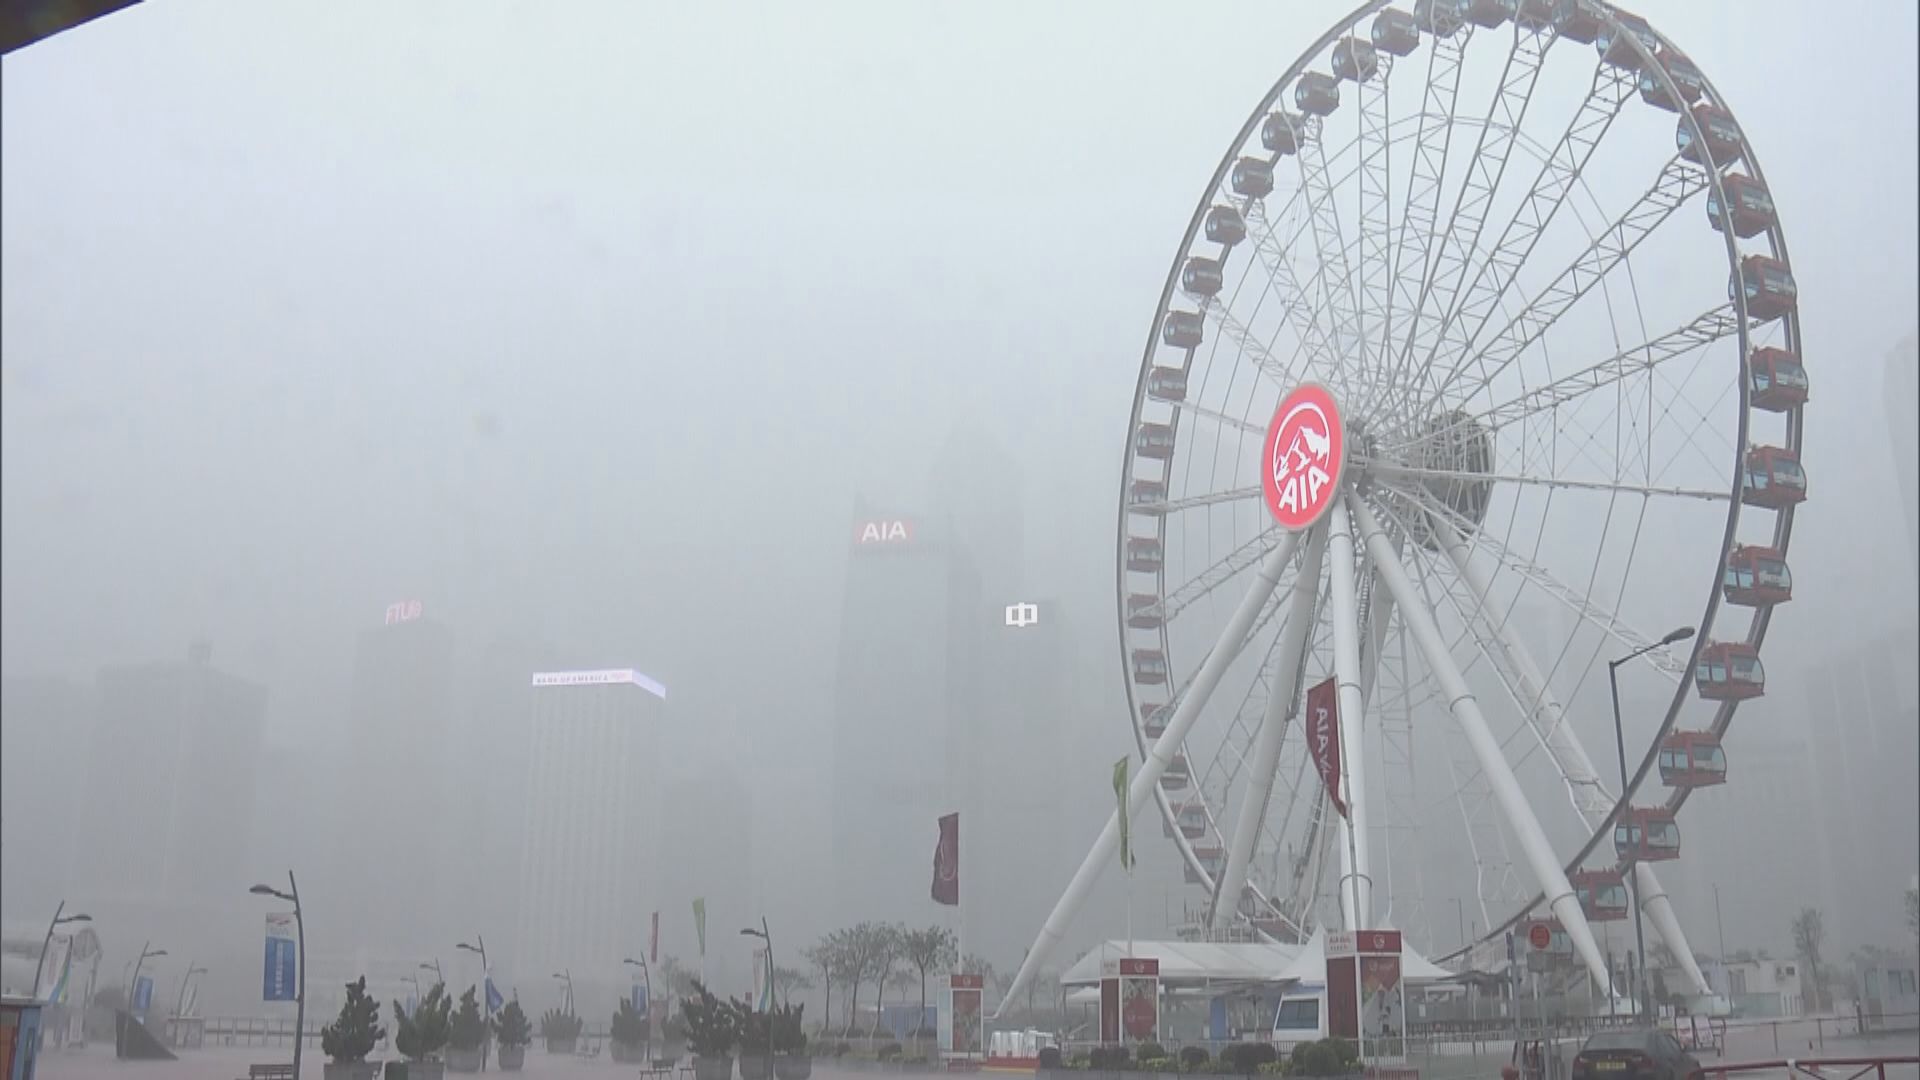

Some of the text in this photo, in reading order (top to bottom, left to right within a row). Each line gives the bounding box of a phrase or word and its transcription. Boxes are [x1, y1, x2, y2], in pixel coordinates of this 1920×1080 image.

[1278, 465, 1330, 514] AIA
[862, 521, 907, 542] AIA
[1316, 707, 1328, 753] AIA
